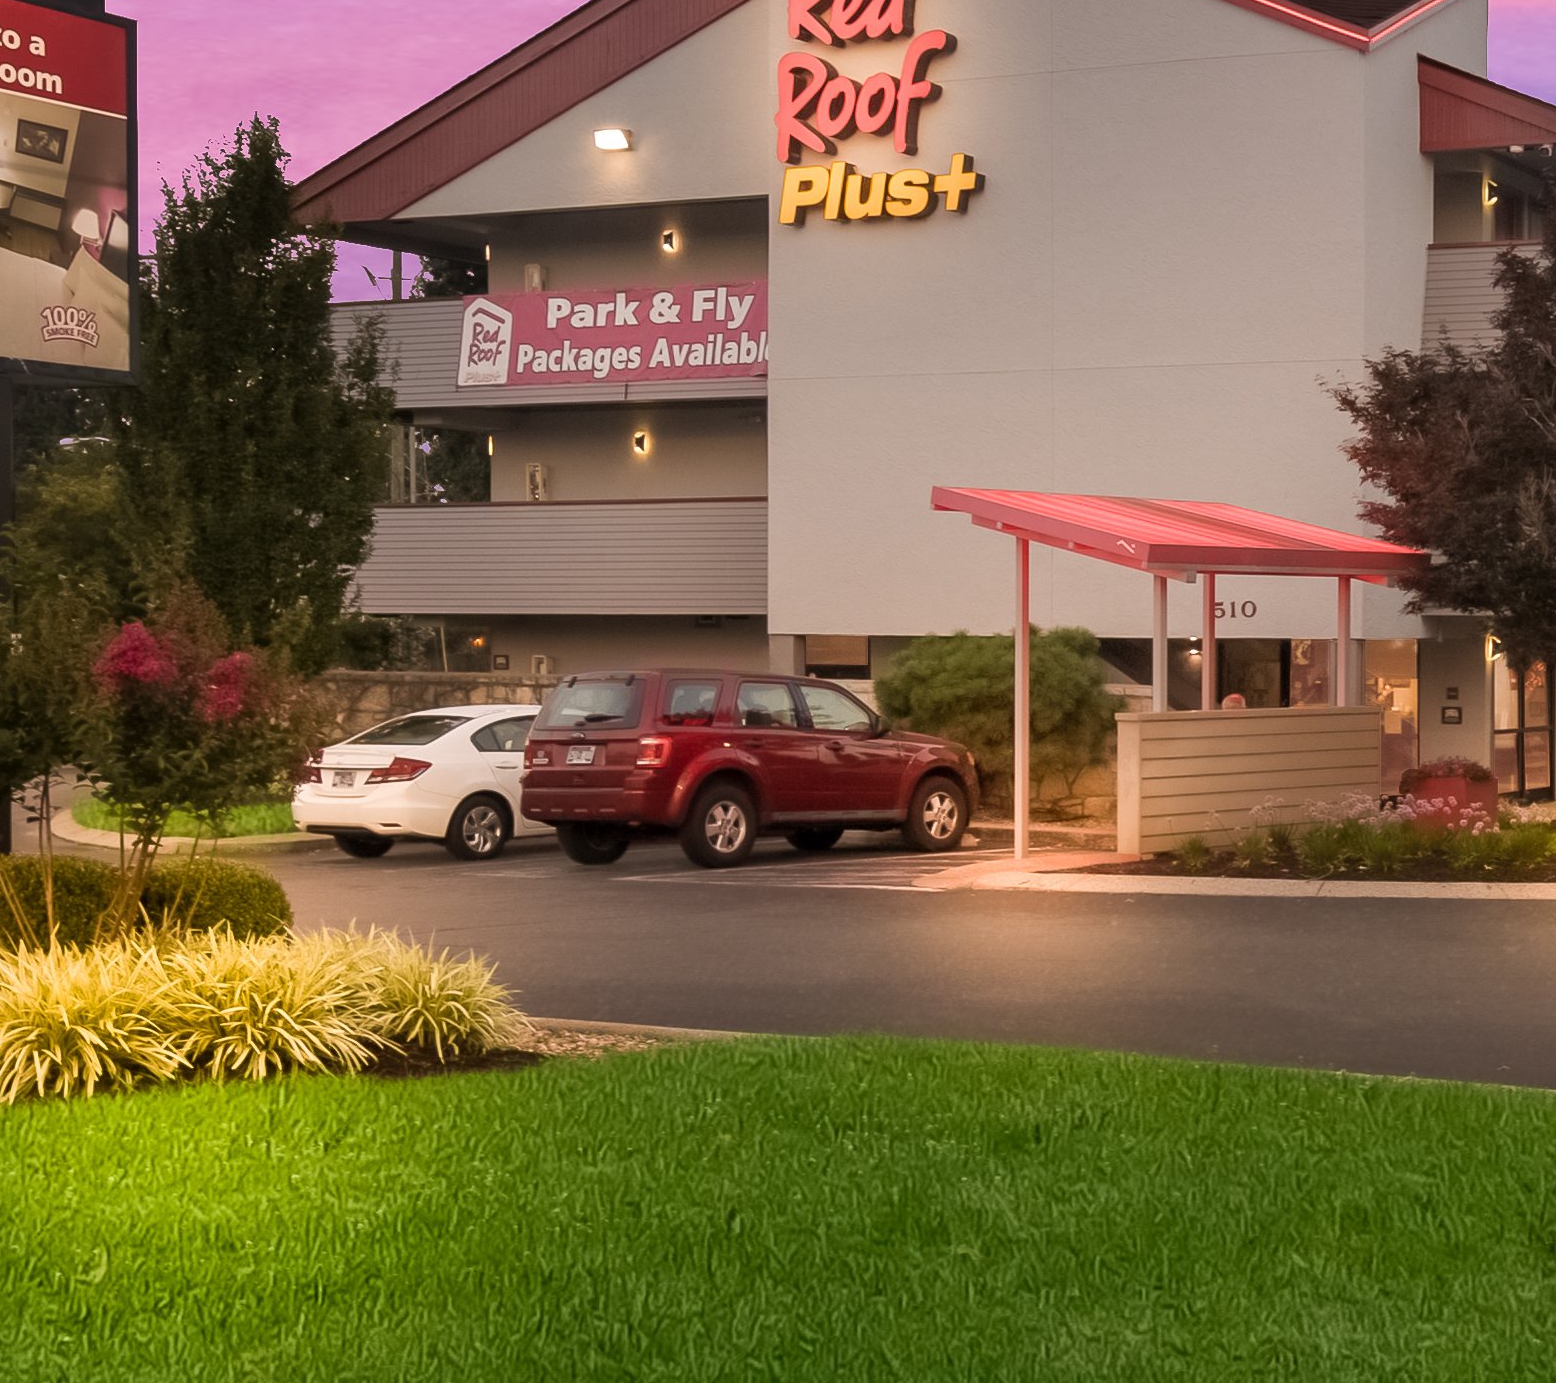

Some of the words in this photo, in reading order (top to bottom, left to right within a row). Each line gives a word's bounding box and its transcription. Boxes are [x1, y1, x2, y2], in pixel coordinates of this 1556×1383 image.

[28, 34, 46, 57] a
[775, 29, 958, 164] Roof
[779, 153, 985, 226] Plus+
[41, 306, 97, 333] 100%
[547, 292, 641, 329] Park
[649, 291, 682, 324] &
[692, 286, 755, 330] Fly
[46, 327, 75, 337] SMOKE
[76, 328, 96, 343] FREE
[472, 322, 501, 345] Red
[468, 340, 507, 368] Roof
[516, 340, 642, 379] Packages
[1214, 600, 1257, 618] 510
